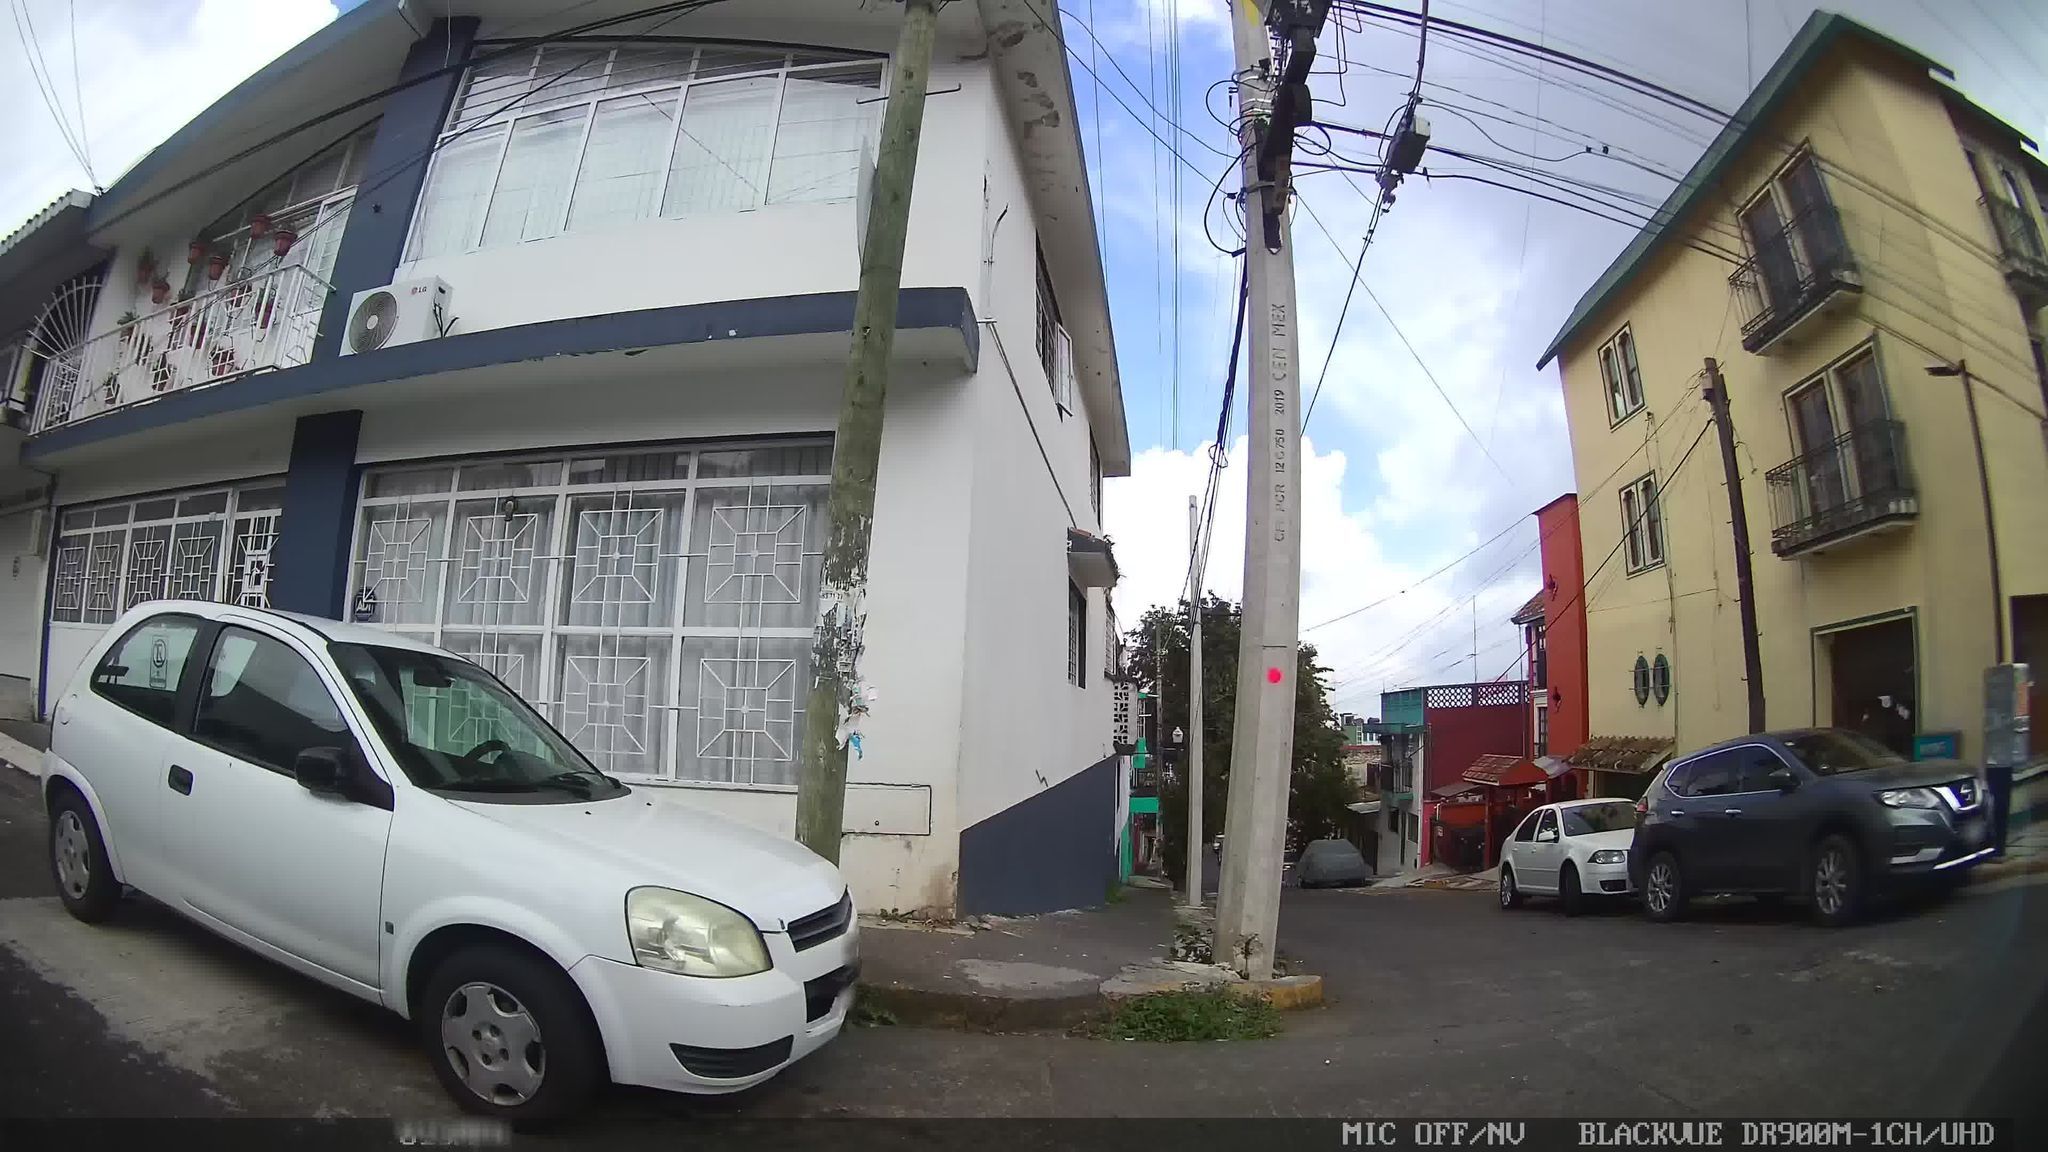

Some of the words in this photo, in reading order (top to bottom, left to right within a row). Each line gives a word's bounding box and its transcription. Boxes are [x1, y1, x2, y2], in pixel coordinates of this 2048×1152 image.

[1272, 304, 1286, 337] MEX
[1272, 348, 1286, 381] CEN
[1273, 390, 1285, 415] 2019
[1274, 484, 1285, 513] PCR
